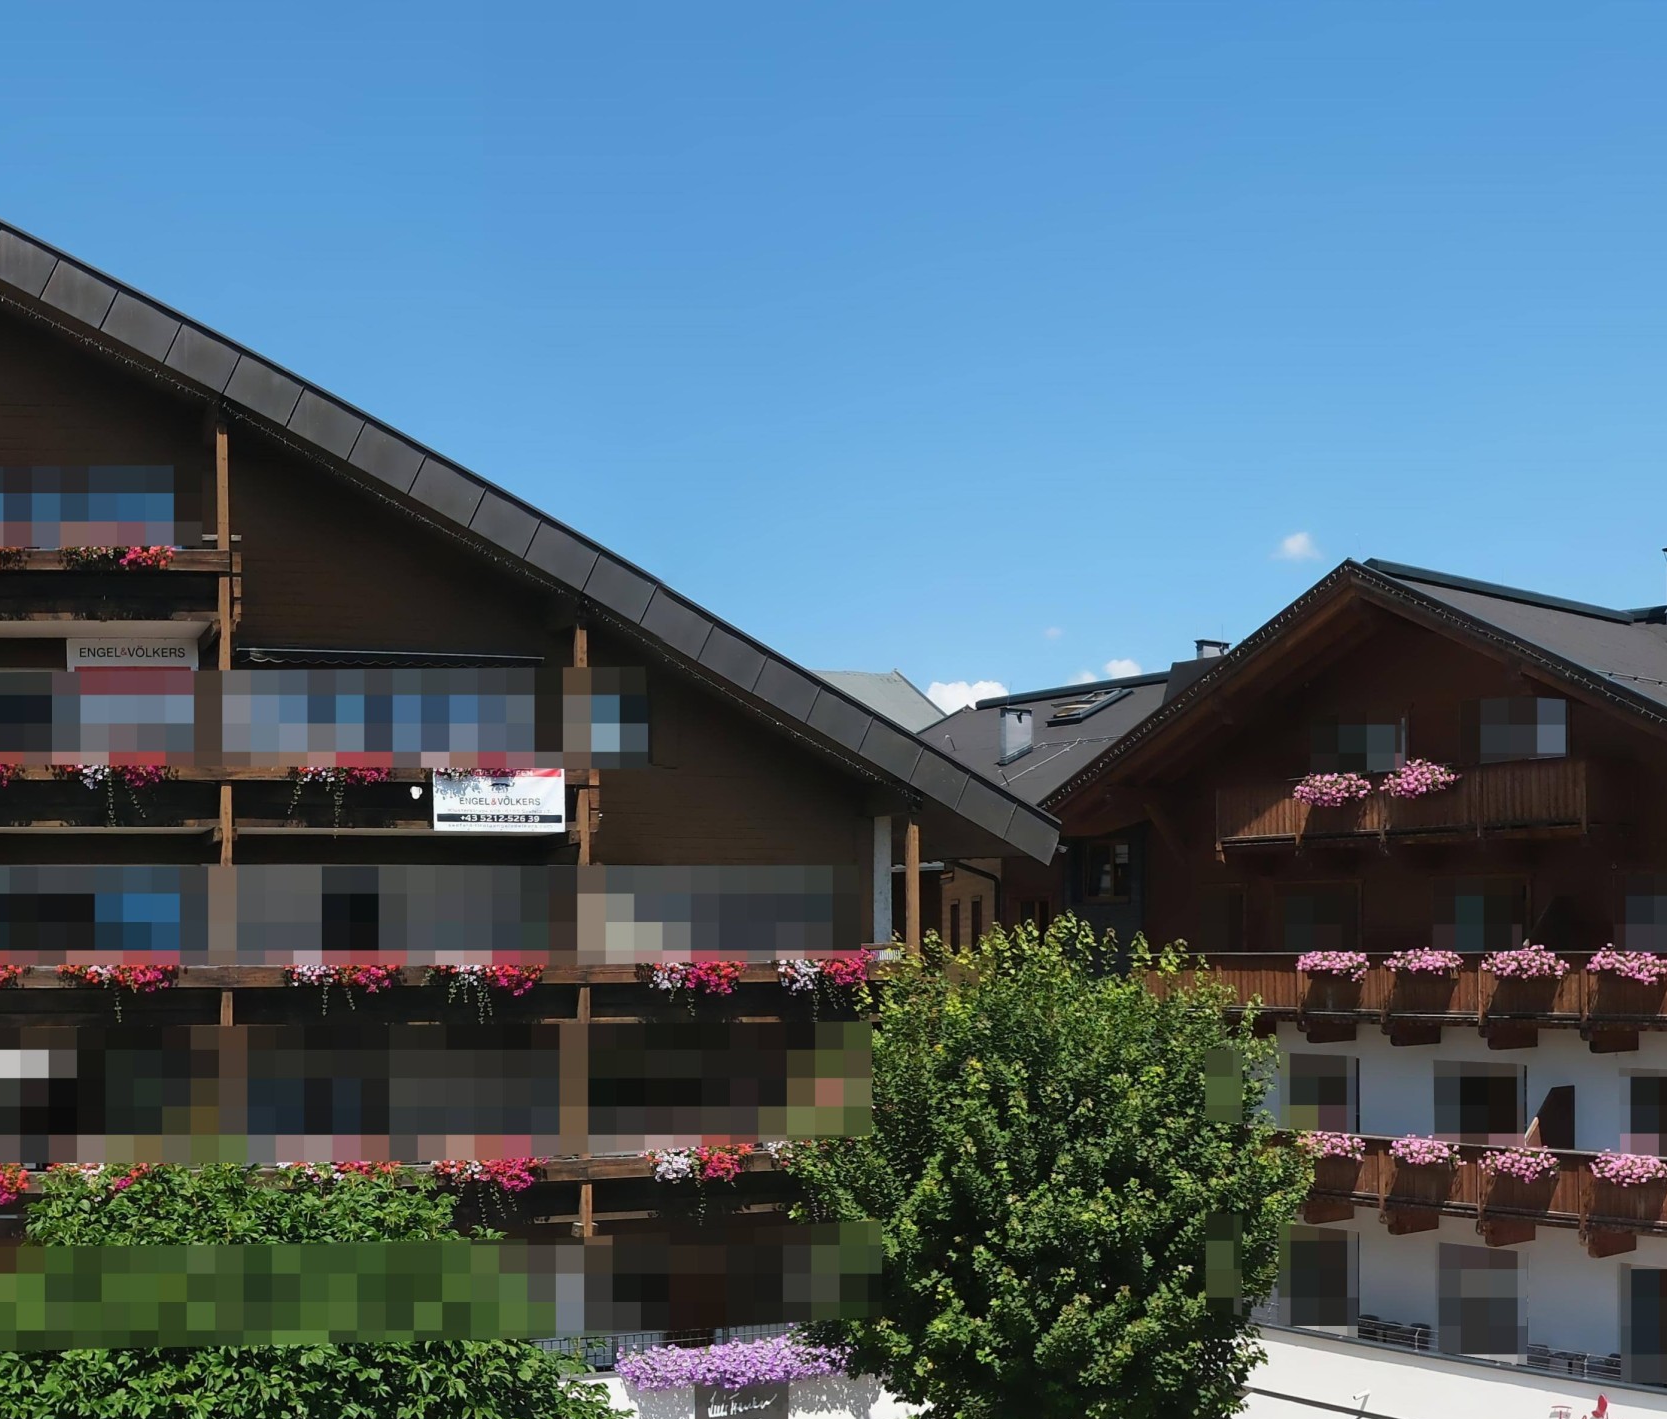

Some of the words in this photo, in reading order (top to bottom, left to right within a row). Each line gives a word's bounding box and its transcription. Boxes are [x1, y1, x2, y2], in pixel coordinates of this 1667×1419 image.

[459, 796, 541, 806] ENGEL&VÖLKERS
[479, 815, 526, 823] 5212-526
[527, 815, 540, 823] 39
